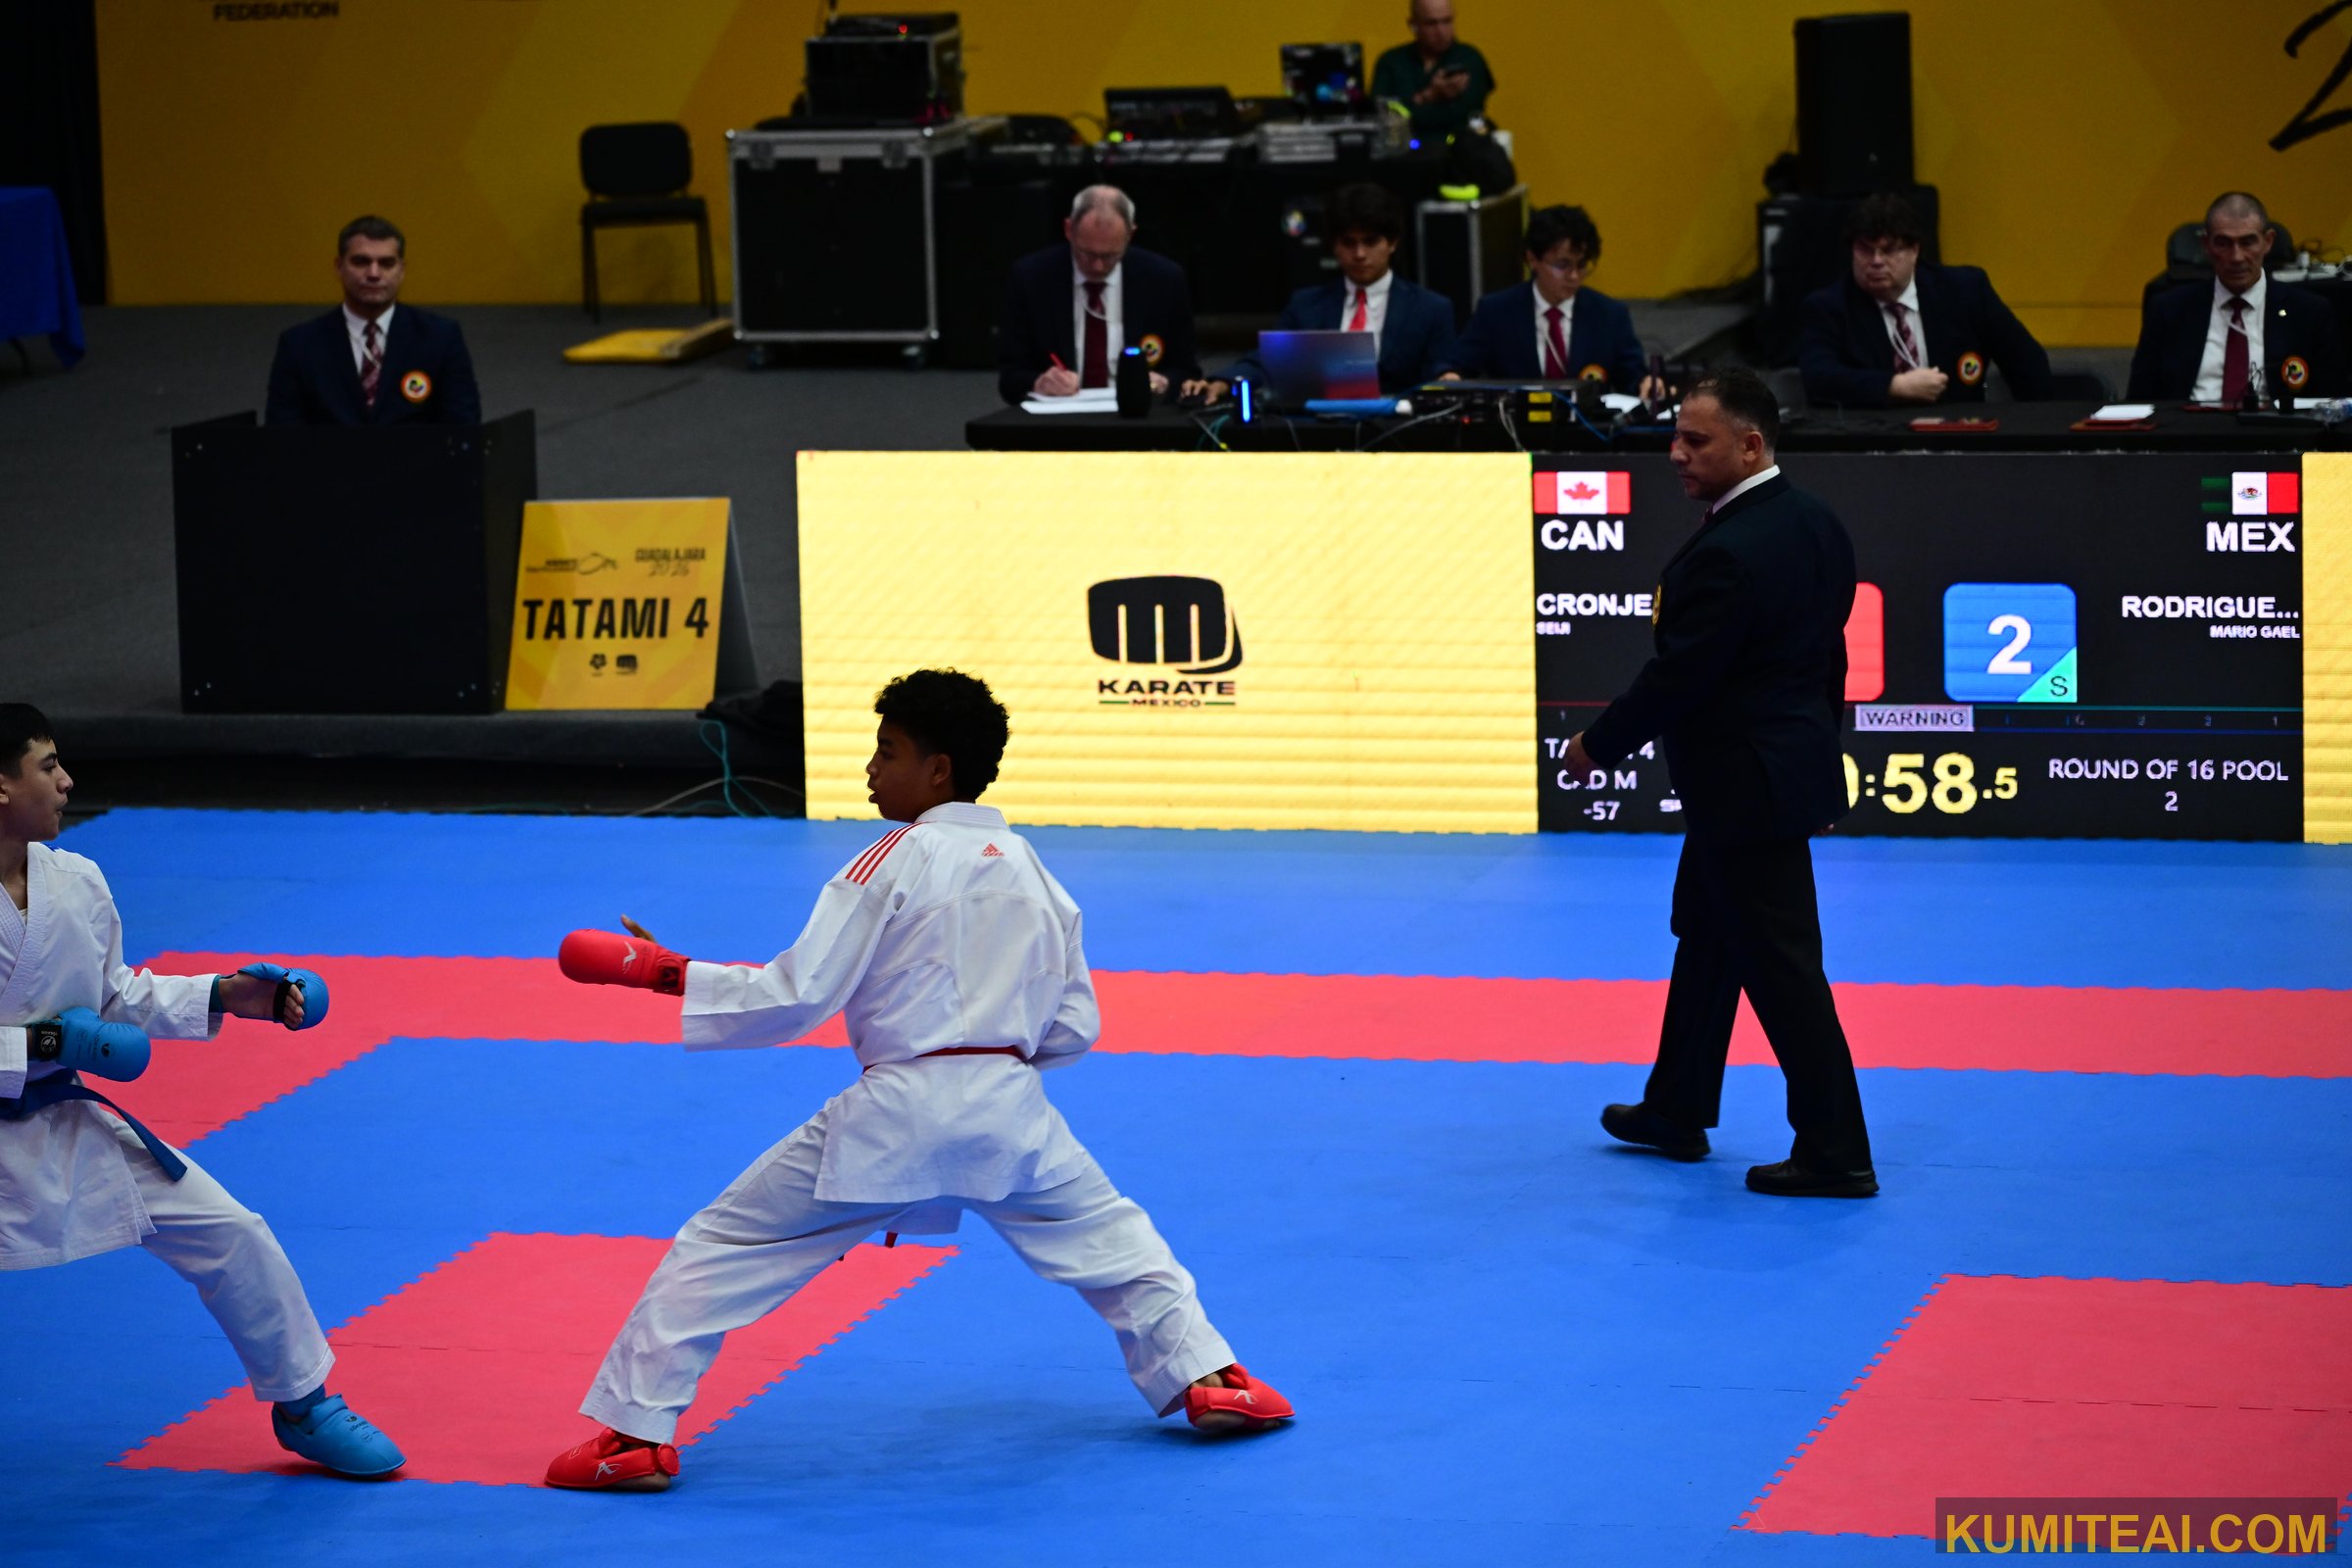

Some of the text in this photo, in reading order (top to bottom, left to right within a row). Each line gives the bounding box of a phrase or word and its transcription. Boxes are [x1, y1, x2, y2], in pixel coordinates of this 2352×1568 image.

[213, 2, 340, 22] FEDERATION
[1541, 519, 1624, 551] CAN
[2206, 521, 2295, 552] MEX
[1536, 593, 1653, 615] CRONJE
[2122, 596, 2299, 618] RODRIGUE...
[522, 597, 709, 640] TATAMI 4
[2210, 625, 2300, 638] MARIO GAEL
[1986, 614, 2032, 674] 2
[1099, 680, 1236, 695] KARATE
[2050, 676, 2068, 697] S
[1132, 699, 1200, 708] MEXICO
[1867, 711, 1964, 726] WARNING
[1556, 769, 1638, 790] CD M
[2048, 759, 2288, 781] ROUND OF 16 POOL
[1583, 801, 1620, 820] -57
[2164, 791, 2179, 811] 2
